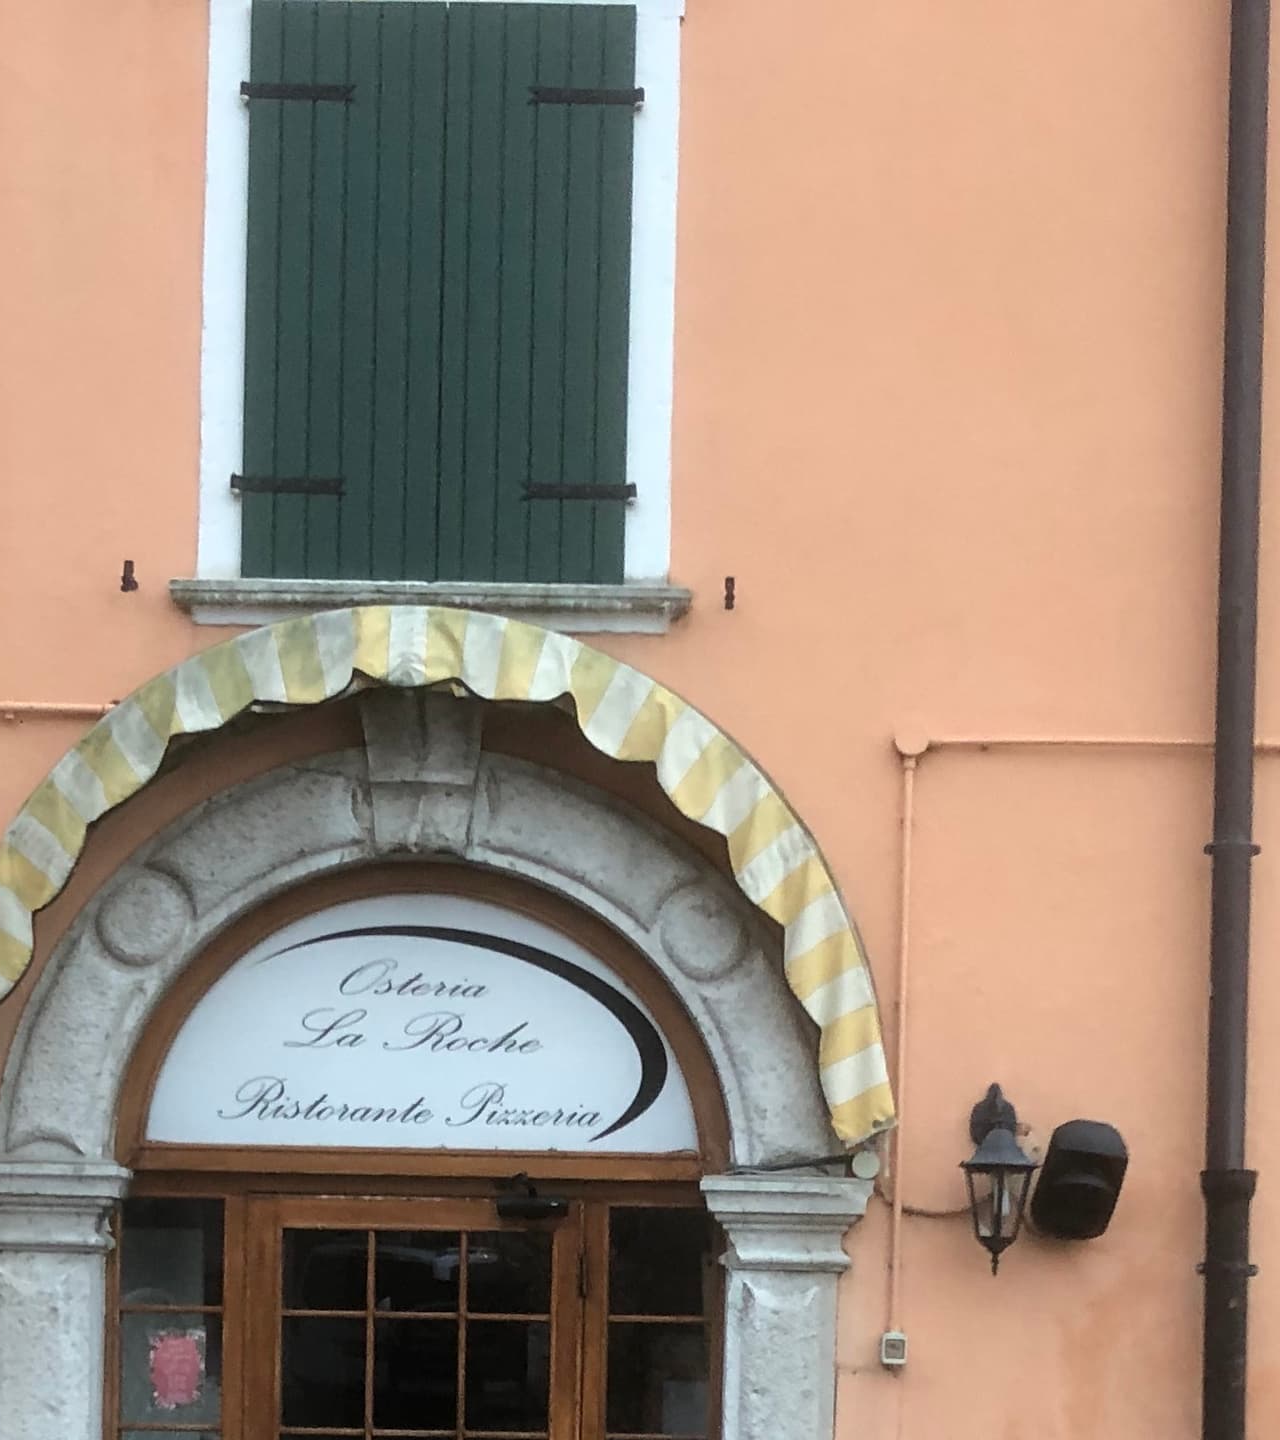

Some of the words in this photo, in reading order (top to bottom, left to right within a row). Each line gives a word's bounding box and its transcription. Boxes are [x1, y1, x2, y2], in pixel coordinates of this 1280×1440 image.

[339, 959, 488, 998] Osteria
[283, 1007, 367, 1049] La
[382, 1011, 544, 1056] Roche
[217, 1075, 434, 1125] Ristorante
[445, 1082, 602, 1129] Pizzeria
